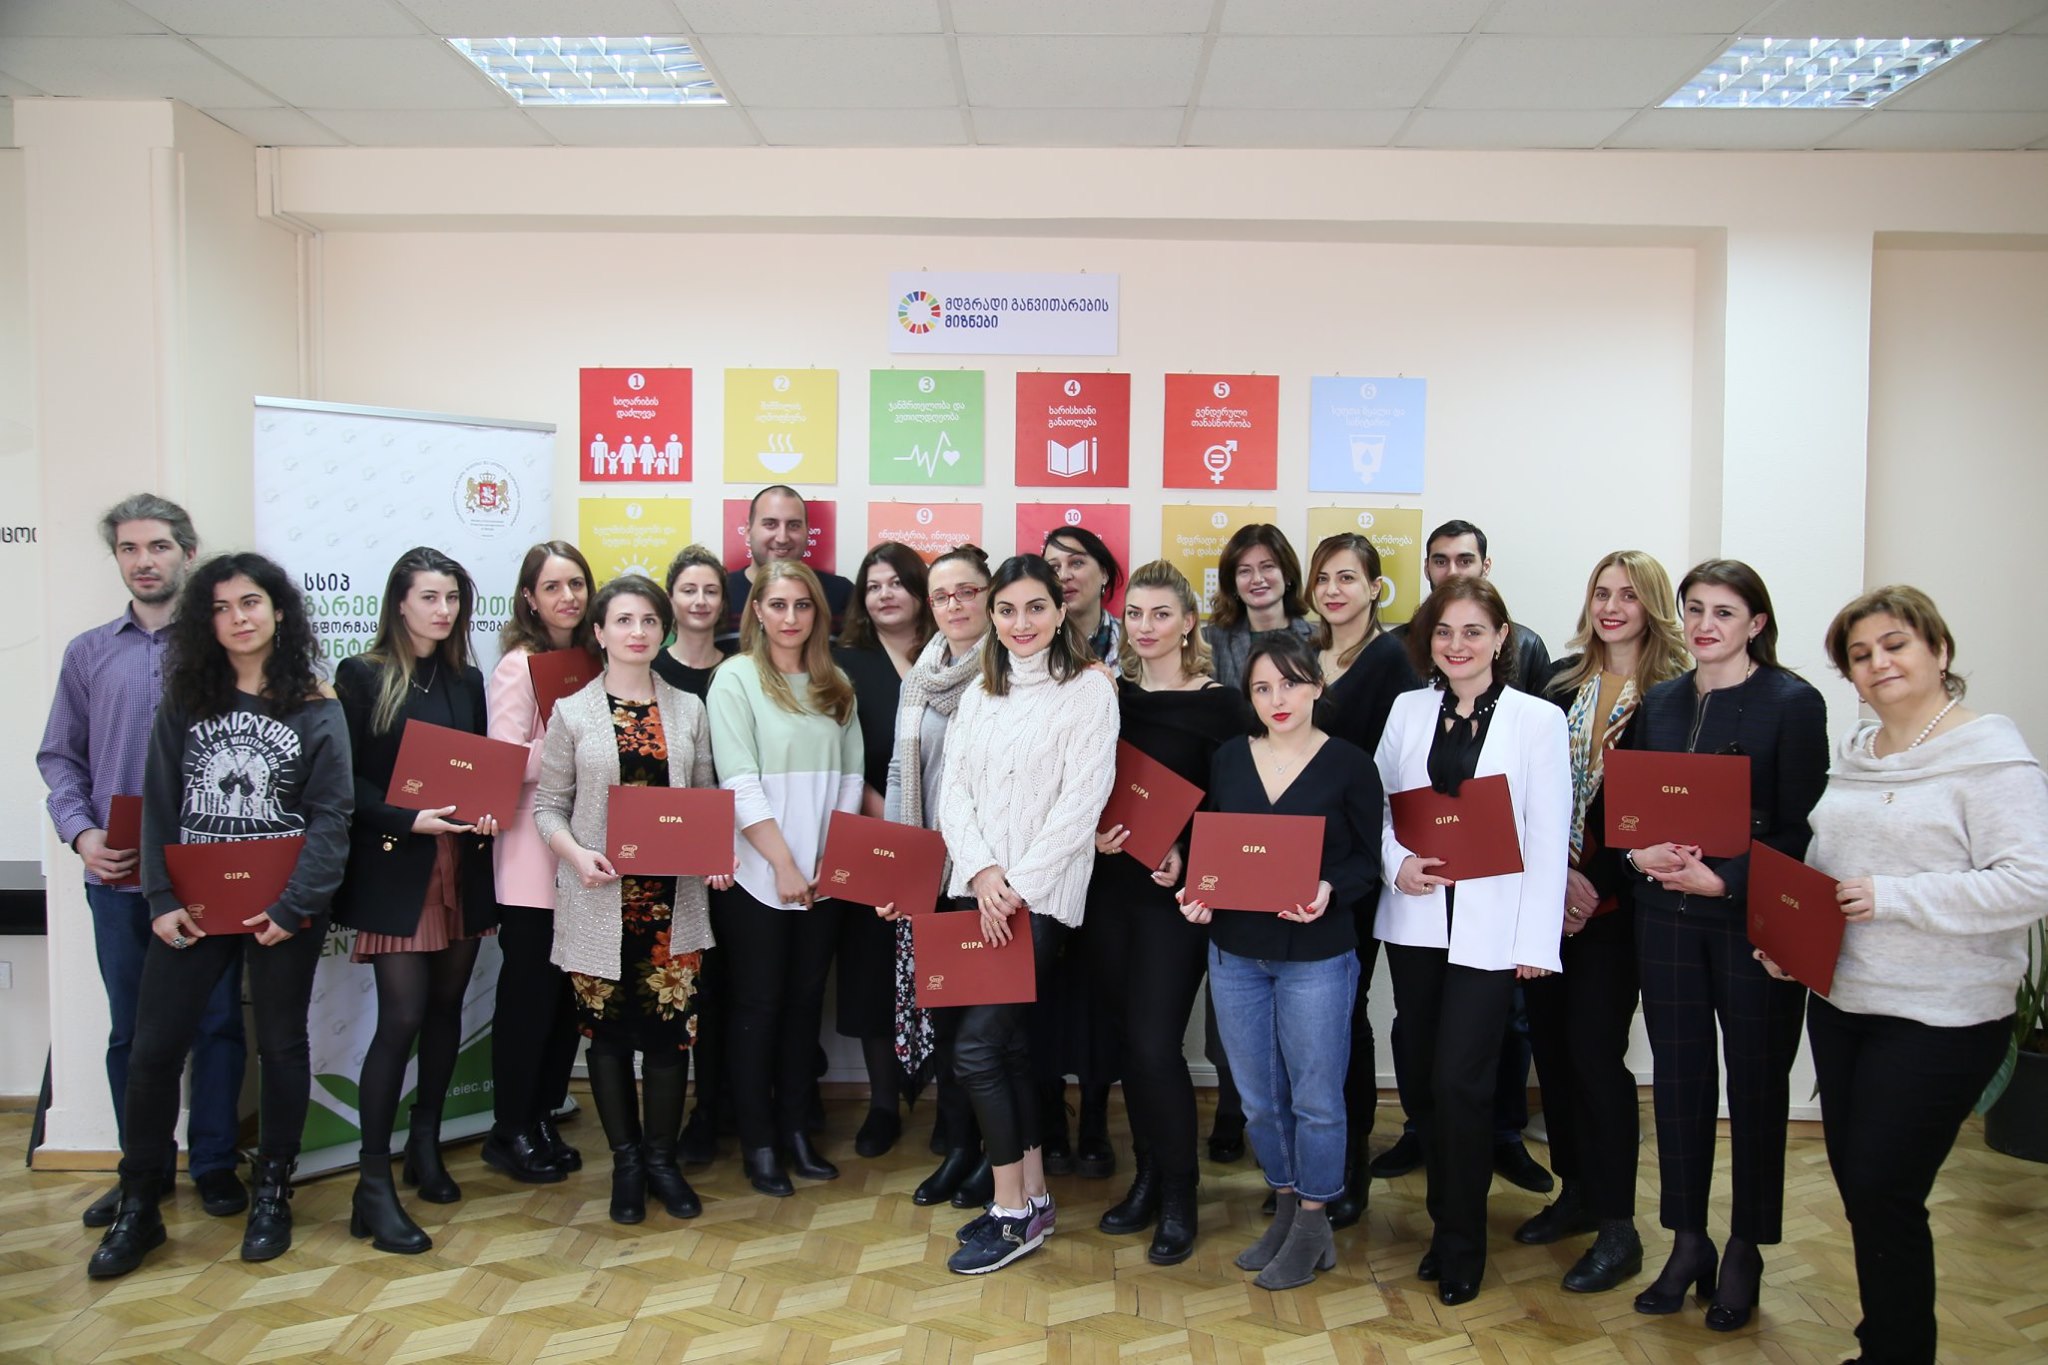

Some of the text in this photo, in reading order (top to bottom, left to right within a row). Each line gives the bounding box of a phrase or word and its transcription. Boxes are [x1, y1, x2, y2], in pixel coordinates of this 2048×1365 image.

[945, 297, 1109, 312] მდგრადი განვითარების
[945, 314, 999, 328] მიზნები
[1067, 512, 1080, 522] 10
[1214, 515, 1225, 525] 11
[1361, 515, 1372, 525] 12
[304, 572, 350, 591] სსიპ
[449, 758, 473, 771] GIPA
[1131, 783, 1150, 800] GIPA
[1662, 785, 1689, 795] GIPA
[659, 815, 684, 824] GIPA
[1435, 814, 1460, 825] GIPA
[873, 847, 896, 859] GIPA
[1242, 845, 1267, 854] GIPA
[224, 871, 251, 880] GIPA
[961, 941, 984, 950] GIPA
